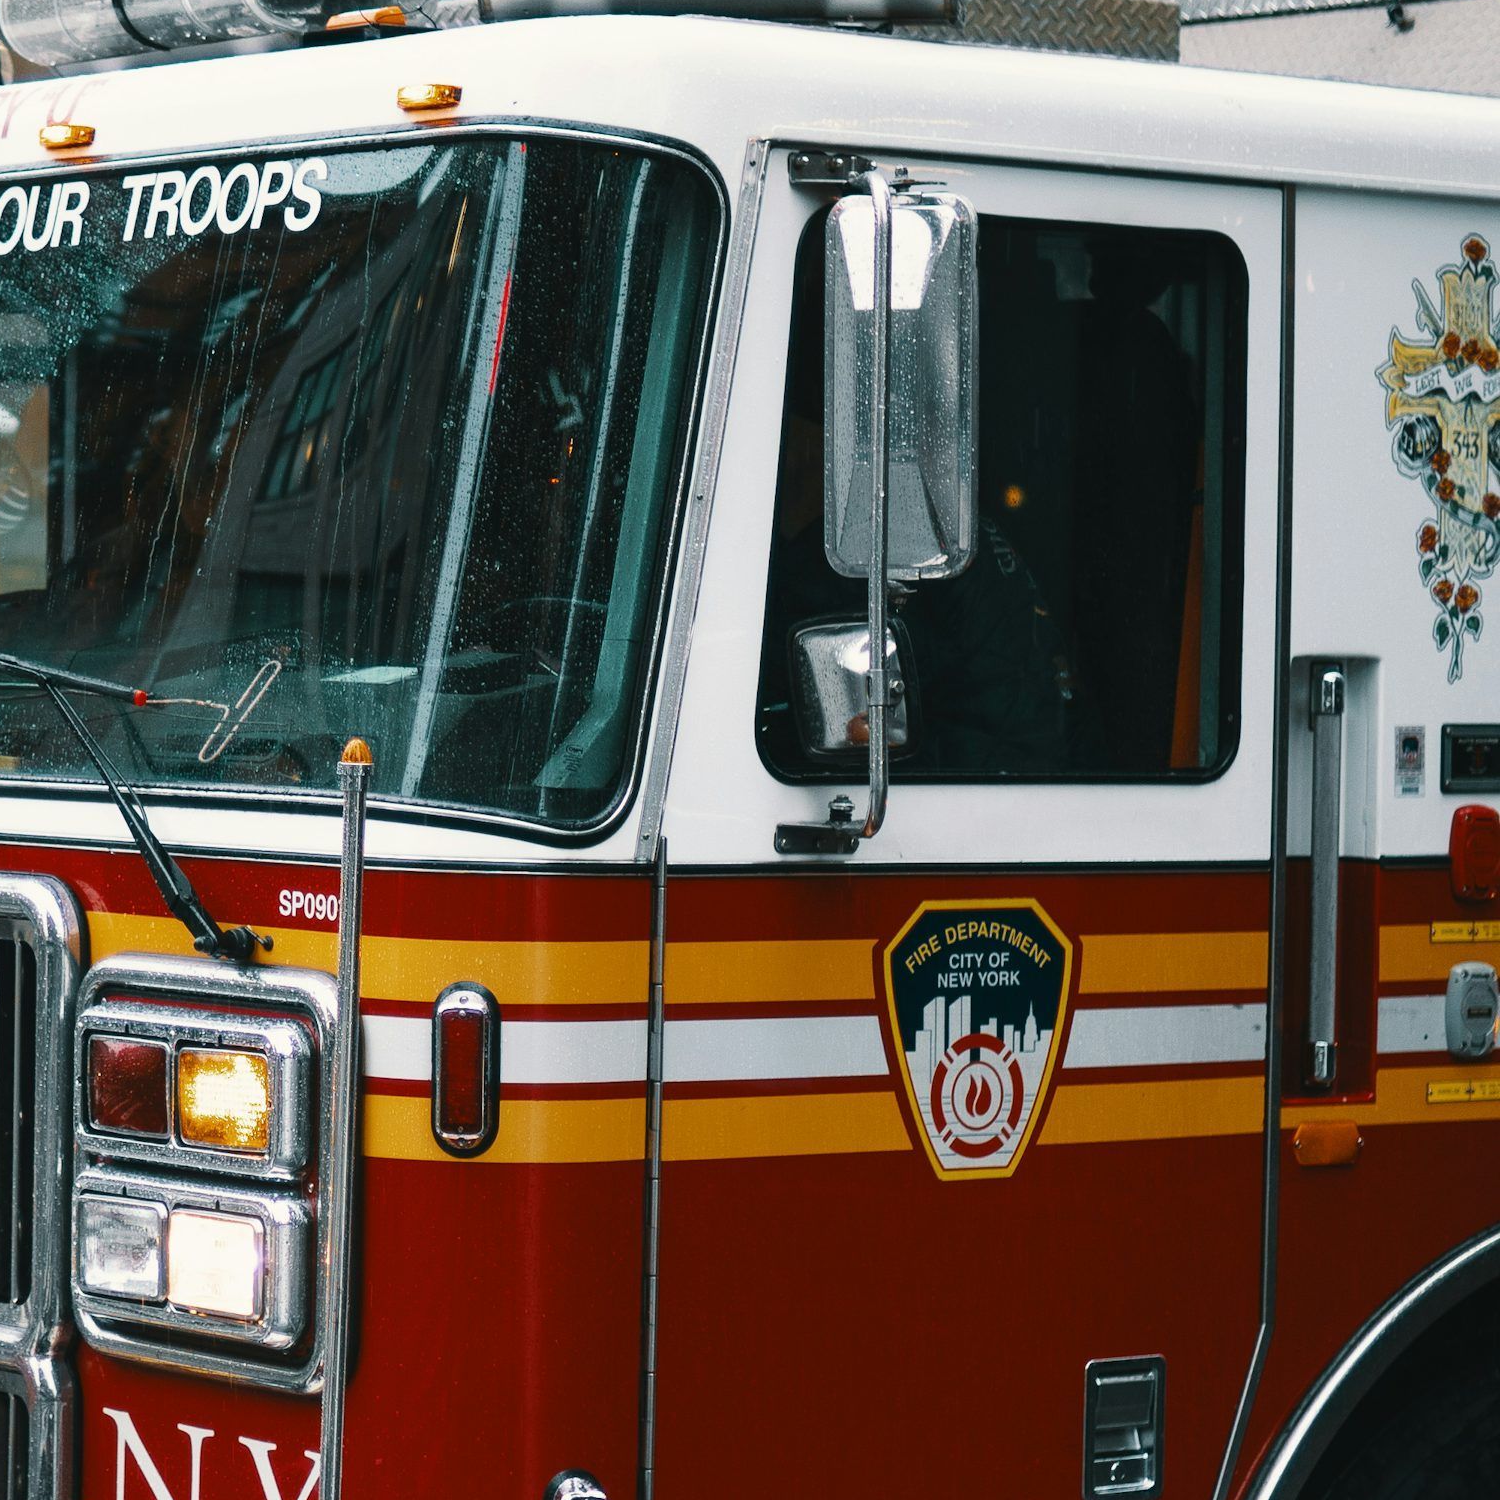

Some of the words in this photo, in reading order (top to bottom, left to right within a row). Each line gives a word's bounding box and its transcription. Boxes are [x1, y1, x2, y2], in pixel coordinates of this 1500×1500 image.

[122, 157, 328, 242] TROOPS
[1451, 430, 1480, 460] 343
[278, 888, 342, 922] SP090
[904, 934, 942, 974] FIRE
[945, 920, 1052, 969] DEPARTMENT
[949, 953, 984, 970] CITY
[988, 952, 1011, 969] OF
[937, 972, 974, 989] NEW
[978, 970, 1021, 988] YORK
